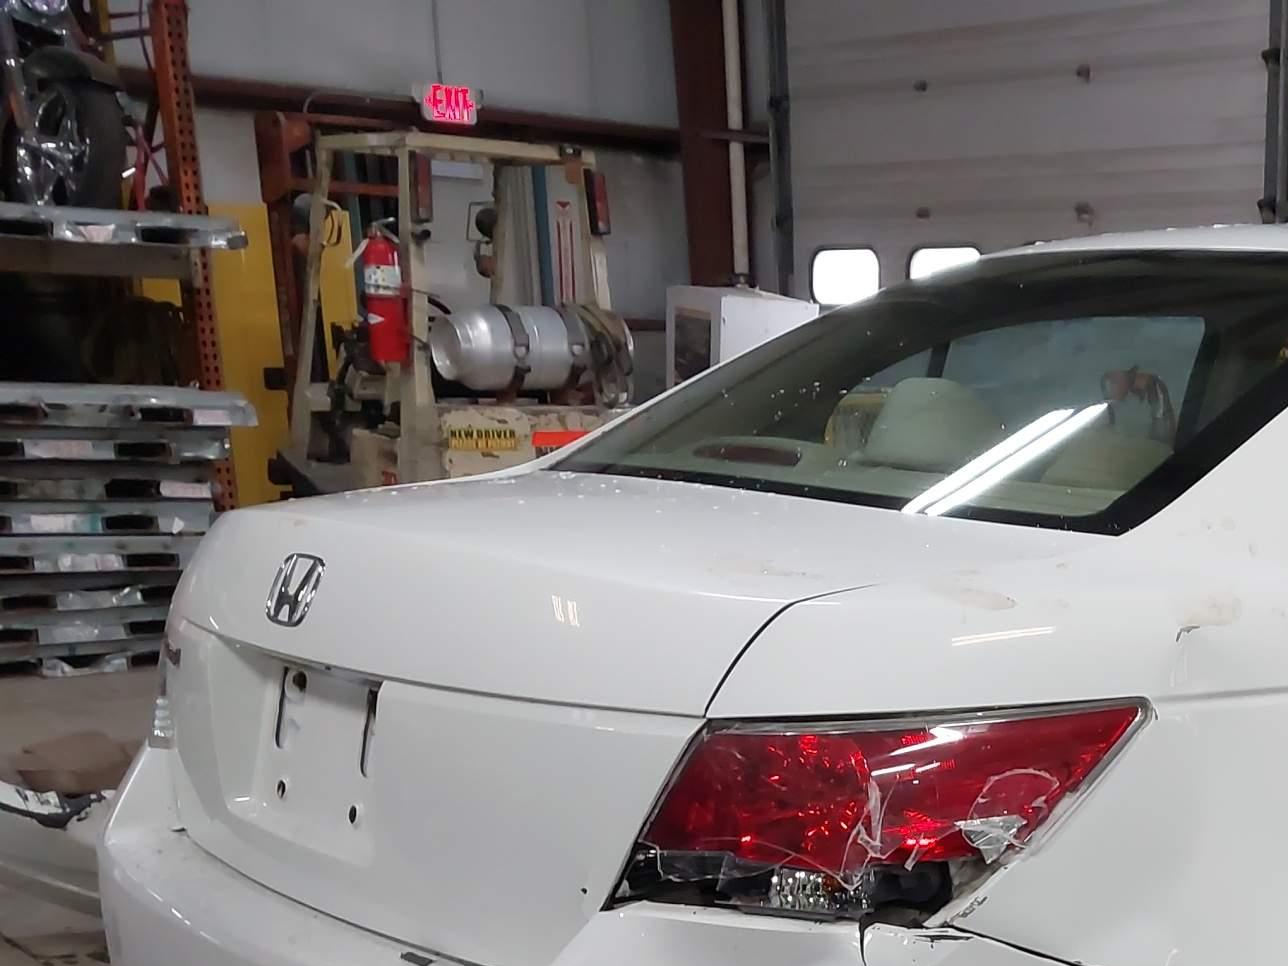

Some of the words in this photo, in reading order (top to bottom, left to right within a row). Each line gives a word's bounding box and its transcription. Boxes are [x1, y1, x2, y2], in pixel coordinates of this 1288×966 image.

[431, 84, 469, 120] EXIT
[450, 428, 474, 439] NEW
[476, 428, 516, 439] DRIVER
